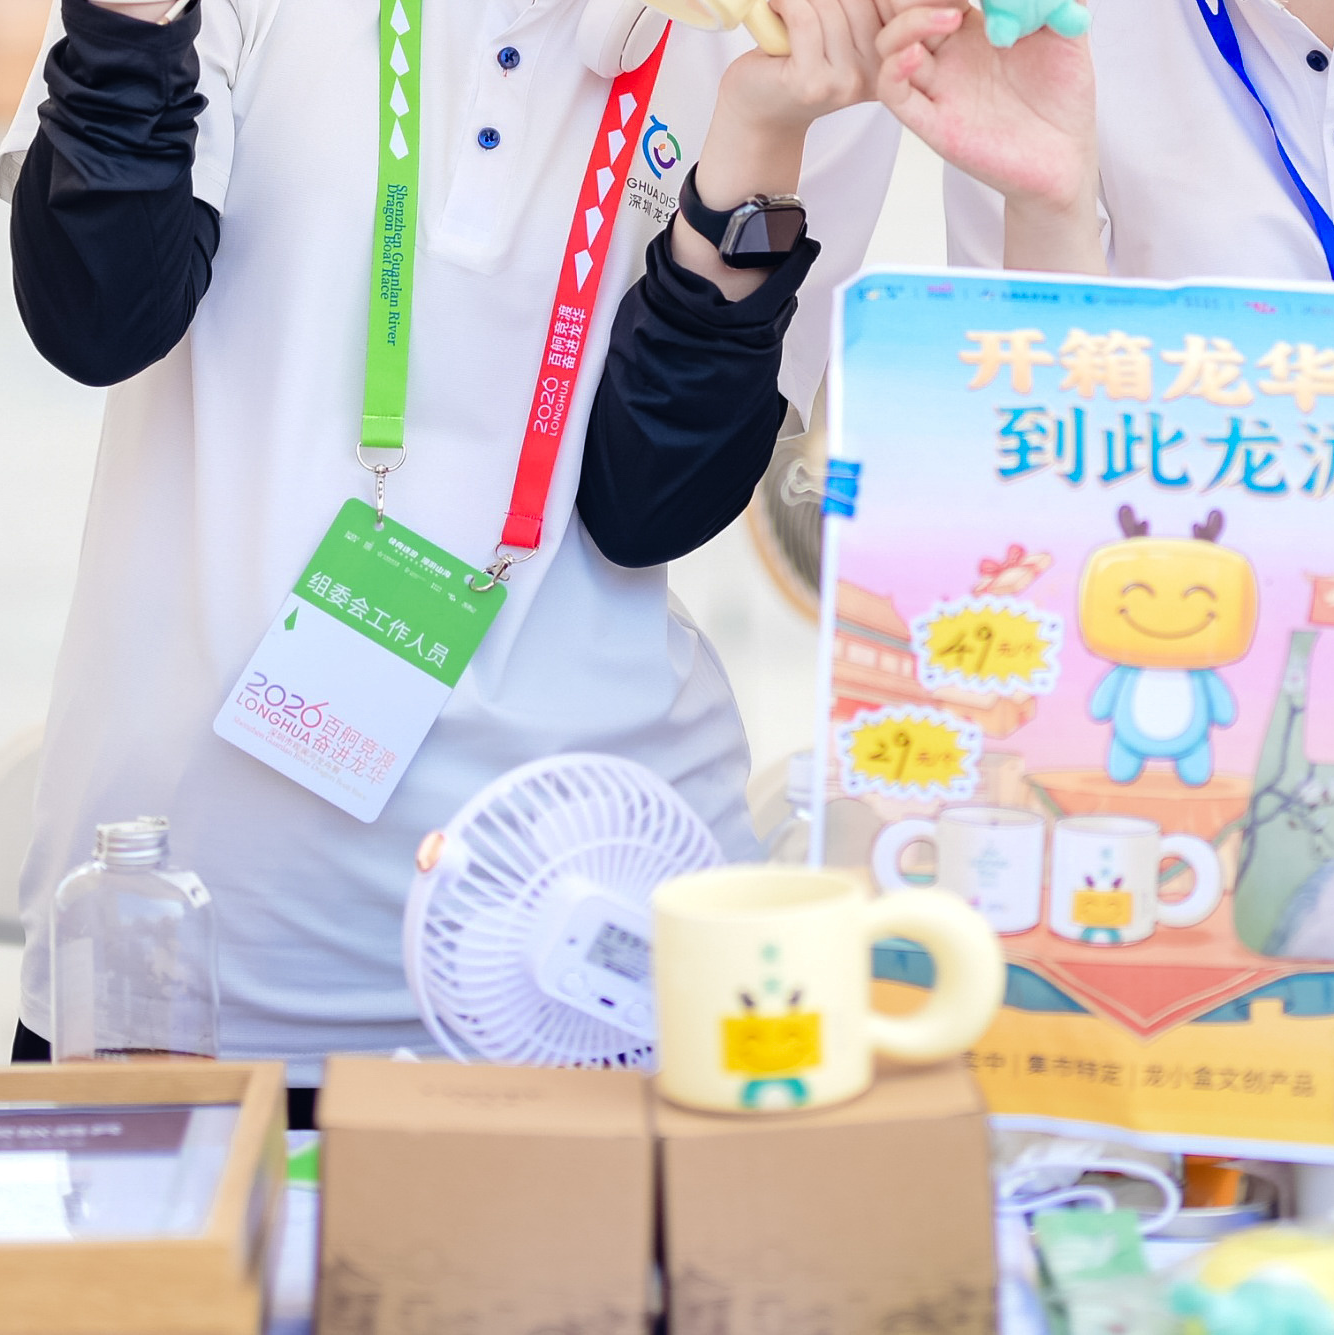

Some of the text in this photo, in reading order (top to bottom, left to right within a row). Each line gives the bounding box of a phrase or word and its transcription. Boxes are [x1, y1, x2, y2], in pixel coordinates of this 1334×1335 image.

[659, 193, 680, 209] DIS
[380, 183, 399, 300] Dragon Boat Race
[386, 184, 408, 346] Shenzhen Guanlan River
[547, 304, 573, 366] 百舸竞渡
[561, 307, 587, 370] 奋进龙华
[533, 376, 559, 434] 2026
[548, 379, 571, 437] LONGHUA
[305, 570, 451, 670] 组委会工作人员
[235, 691, 311, 745] LONGHUA
[245, 671, 329, 729] 2026
[311, 732, 387, 785] 奋进龙华
[321, 713, 398, 770] 百舸竞渡
[1143, 1064, 1315, 1098] 龙小盒文创产品
